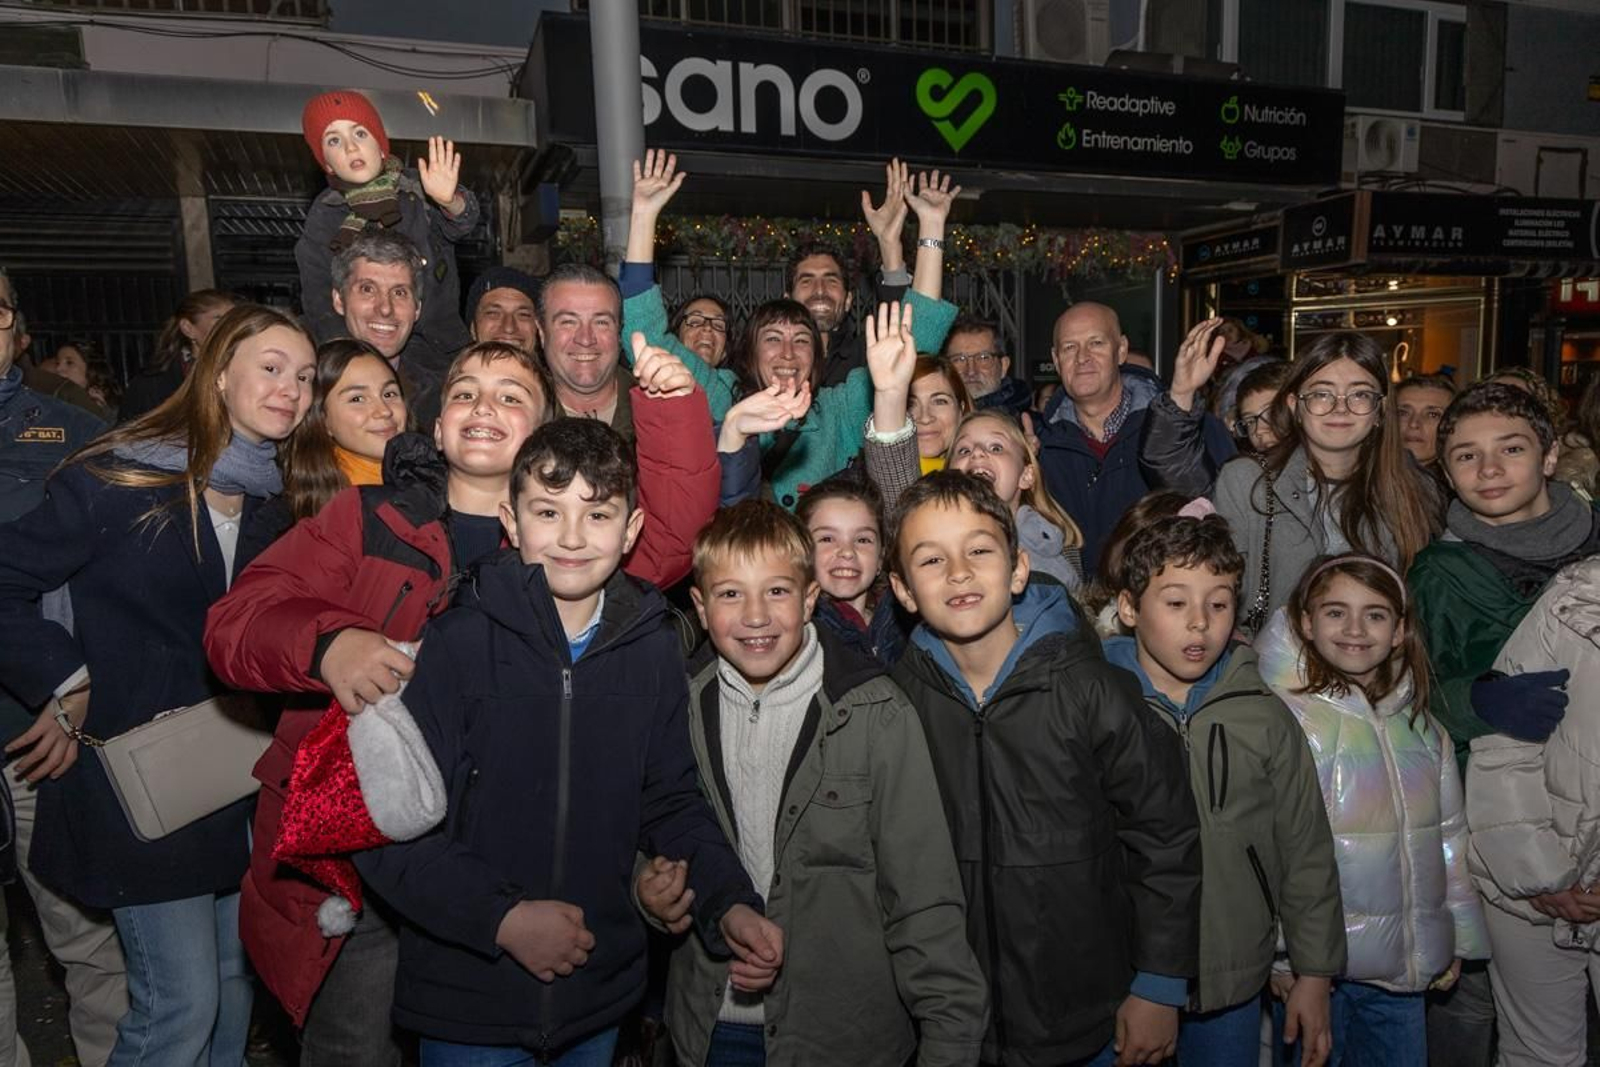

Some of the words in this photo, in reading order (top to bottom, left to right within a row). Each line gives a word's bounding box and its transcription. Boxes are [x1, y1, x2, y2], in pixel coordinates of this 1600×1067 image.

[1087, 91, 1176, 116] Readaptive
[1244, 104, 1306, 126] Nutrición
[1082, 129, 1193, 154] Entrenamiento
[1244, 141, 1297, 163] Grupos
[1373, 224, 1463, 240] AYMAR
[1292, 235, 1345, 253] AYMAR
